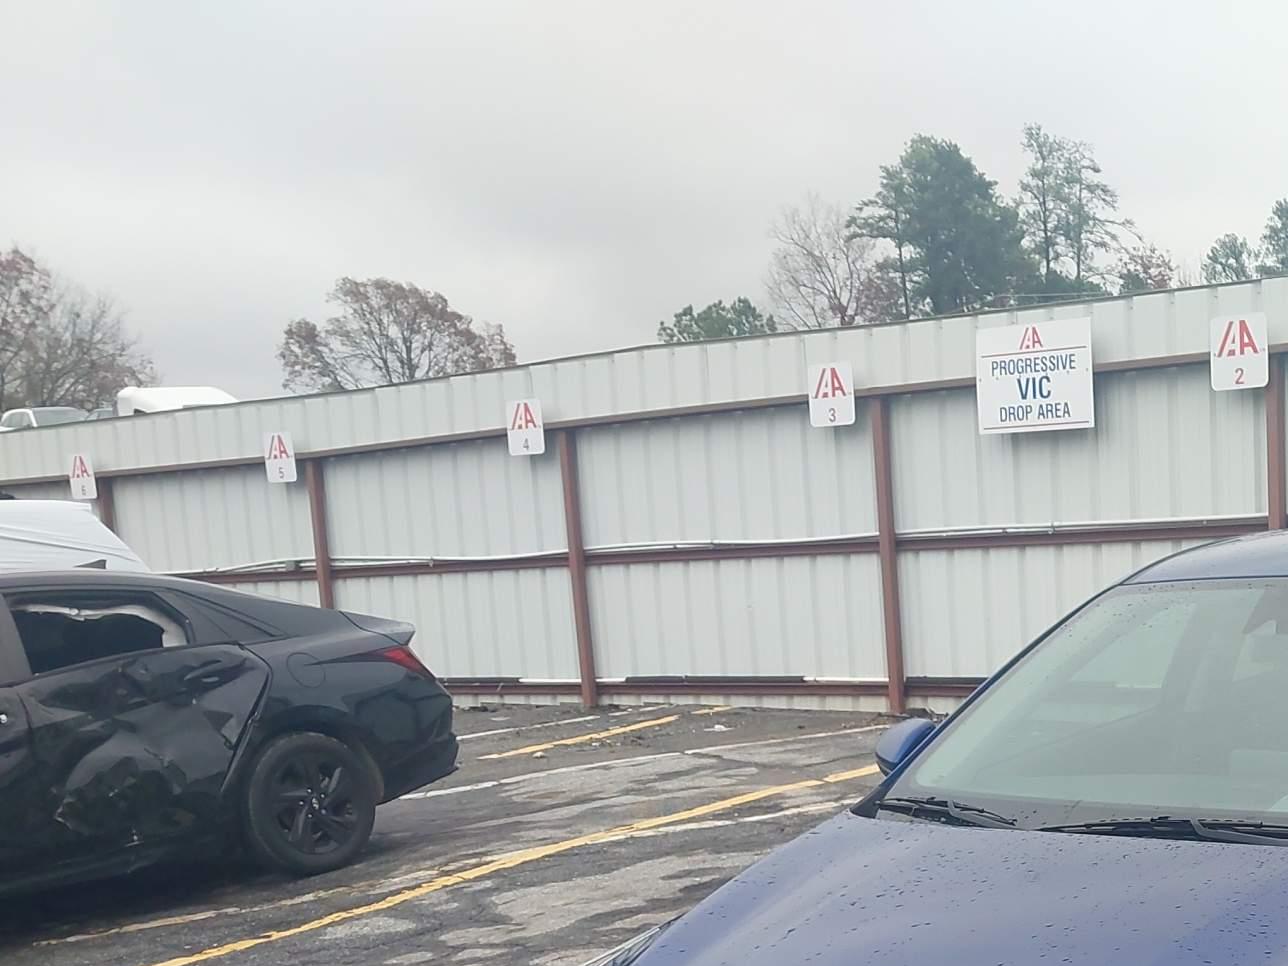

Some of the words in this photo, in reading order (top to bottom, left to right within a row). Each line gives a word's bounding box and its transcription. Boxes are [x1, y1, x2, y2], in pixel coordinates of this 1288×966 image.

[991, 353, 1076, 377] PROGRESSIVE
[1235, 367, 1244, 384] 2
[1016, 375, 1052, 400] VIC
[828, 407, 836, 422] 3
[999, 404, 1033, 422] DROP
[1037, 402, 1071, 420] AREA
[523, 438, 529, 450] 4
[278, 466, 285, 479] 5
